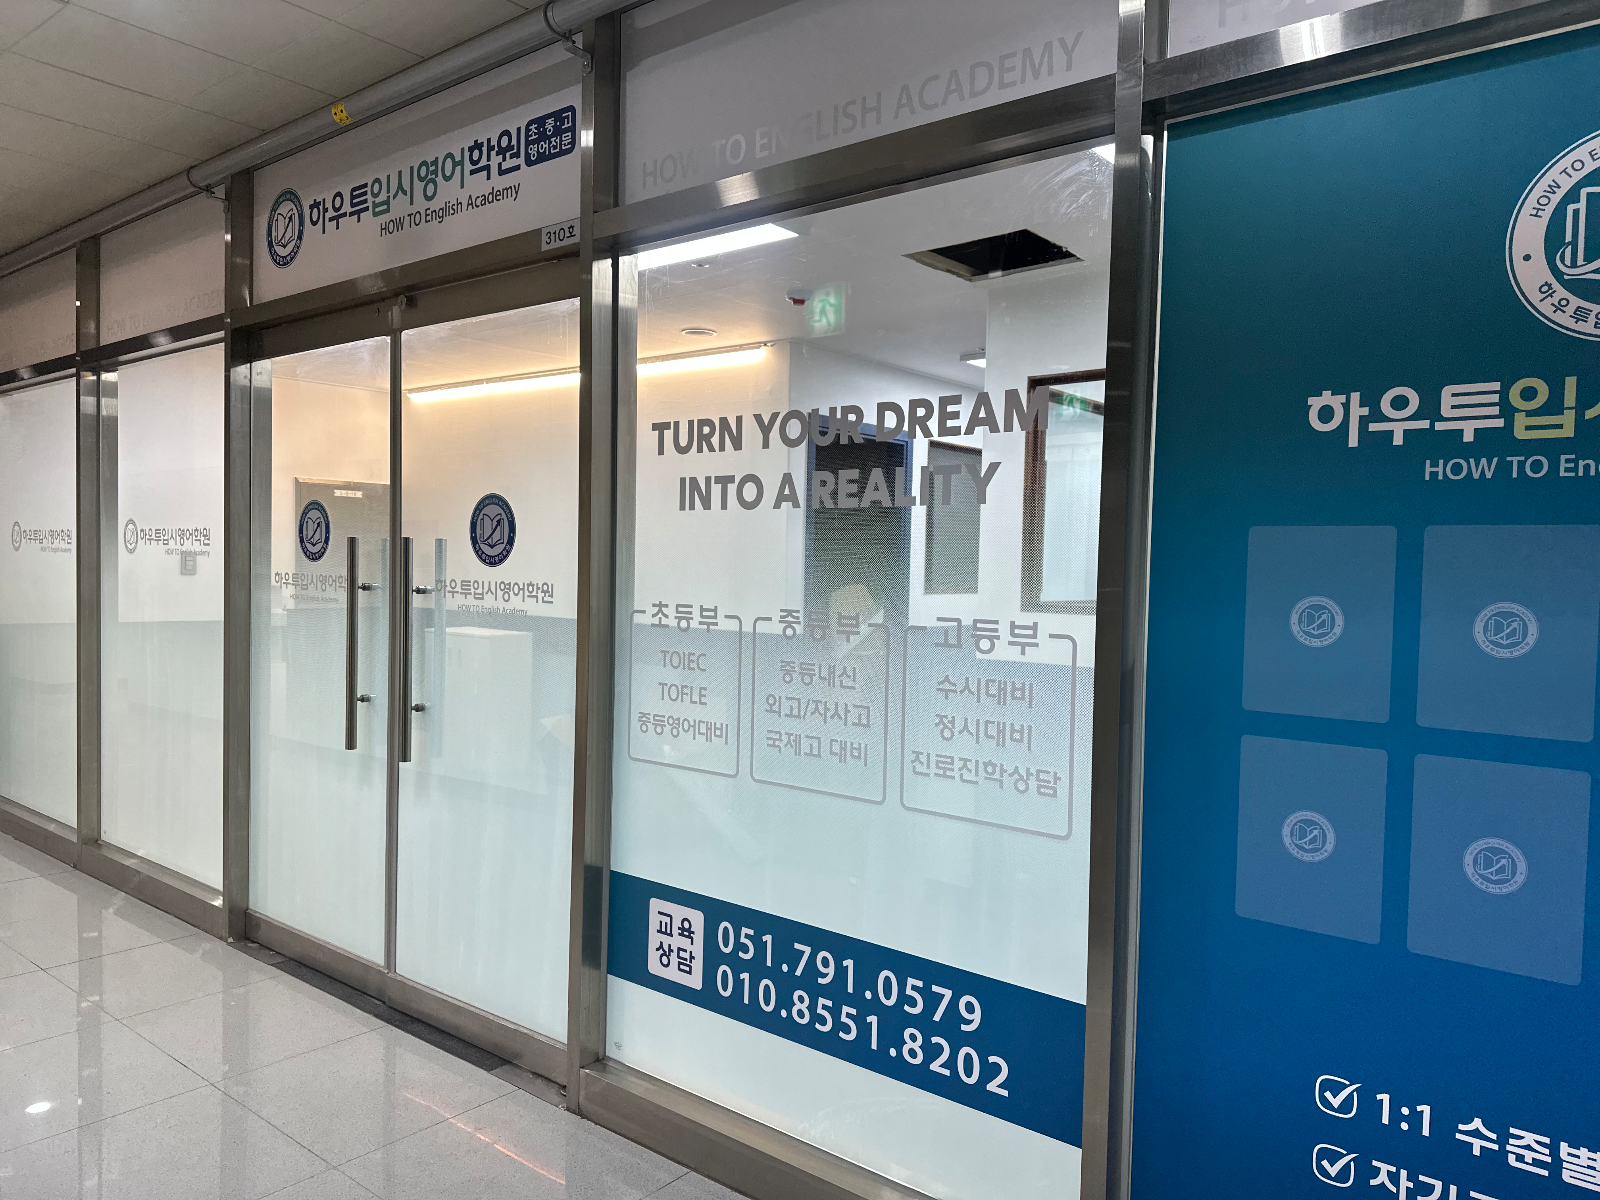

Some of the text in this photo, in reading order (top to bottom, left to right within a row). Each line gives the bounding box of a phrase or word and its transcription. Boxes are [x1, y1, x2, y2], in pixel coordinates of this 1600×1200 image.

[713, 133, 747, 170] TO
[894, 31, 1084, 120] ACADEMY
[528, 132, 572, 160] 영어전문
[309, 126, 521, 235] 하우투입시영어학원
[1529, 179, 1562, 219] HOW
[1559, 158, 1585, 179] TO
[380, 182, 521, 237] HOW TO English Academy
[545, 225, 576, 246] 310호
[1538, 281, 1600, 330] 하우투
[652, 386, 1049, 456] TURN YOUR DREAM
[1307, 376, 1600, 447] 하우투입
[1424, 454, 1600, 481] HOW TO En
[679, 461, 1001, 511] INTO A REALITY
[22, 528, 73, 545] 하우투입시영어학원
[139, 527, 211, 546] 하우투입시영어학원
[274, 571, 347, 593] 하우투입시영어학
[458, 604, 472, 613] HOW
[481, 605, 500, 615] English
[502, 606, 528, 617] Academy
[651, 601, 719, 633] 초등부
[779, 608, 861, 643] 중등부
[935, 617, 1040, 656] 고등부
[660, 650, 707, 673] TOIEC
[779, 660, 857, 690] 중등내신
[659, 682, 708, 706] TOFLE
[936, 677, 1034, 709] 수시대비
[637, 712, 729, 745] 중등영어대비
[765, 694, 871, 729] 외고/자사고
[766, 729, 869, 767] 국제고 대비
[935, 713, 1033, 752] 정시대비
[911, 751, 1062, 799] 진로진학상담
[656, 911, 696, 946] 교육
[655, 942, 695, 975] 상담
[717, 921, 982, 1032] 051.791.0579
[716, 965, 1010, 1098] 010.8551.8202
[1376, 1093, 1431, 1137] 1:1
